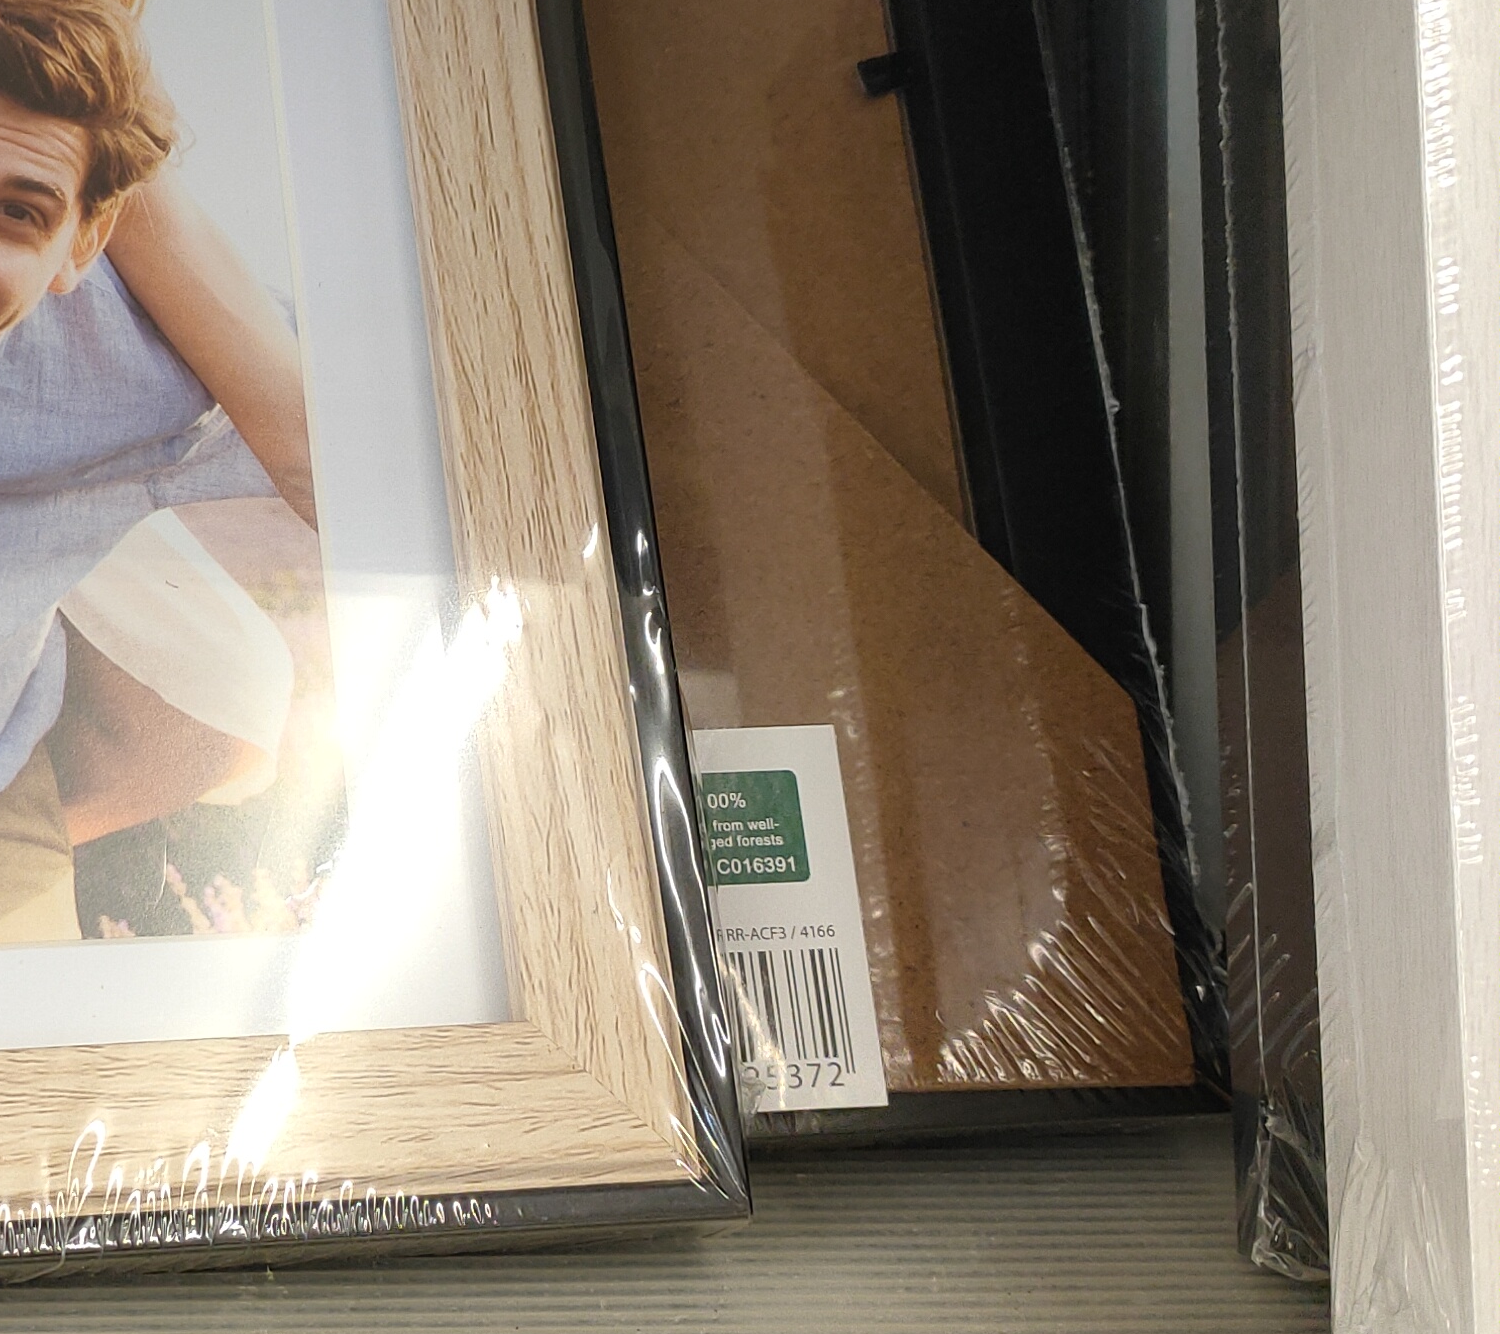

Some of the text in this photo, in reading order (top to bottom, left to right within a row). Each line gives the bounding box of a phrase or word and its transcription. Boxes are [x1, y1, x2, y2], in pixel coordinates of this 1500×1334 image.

[707, 792, 747, 809] 00%
[712, 817, 780, 832] from well-
[736, 834, 784, 847] forests
[716, 855, 797, 875] C016391
[790, 925, 796, 941] /
[800, 924, 836, 939] 4166
